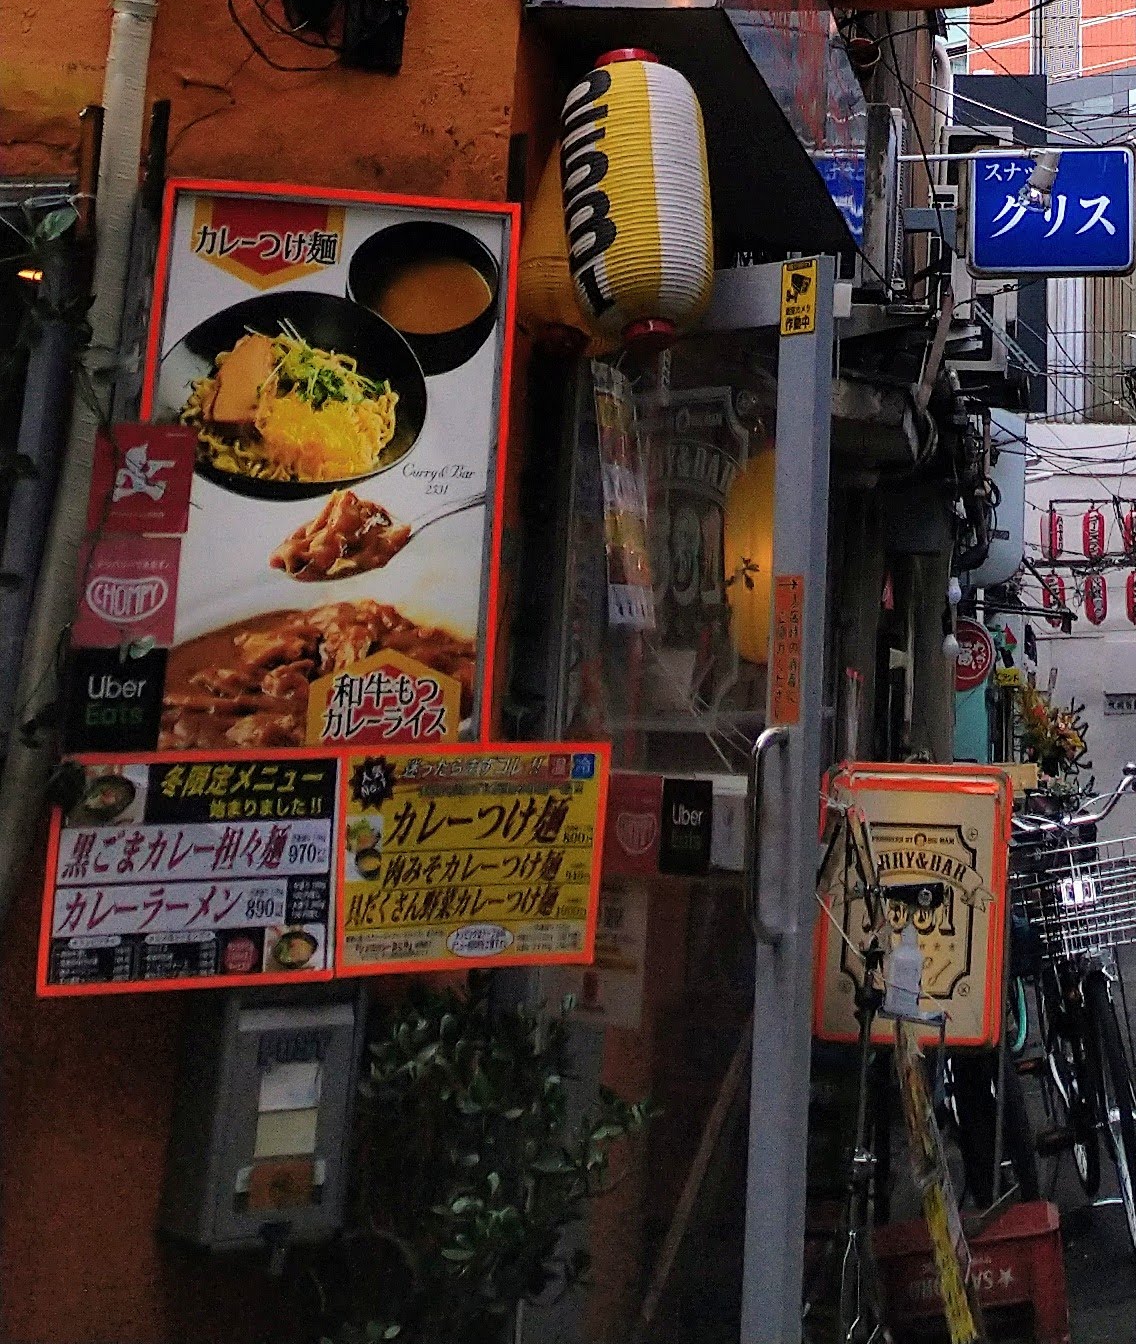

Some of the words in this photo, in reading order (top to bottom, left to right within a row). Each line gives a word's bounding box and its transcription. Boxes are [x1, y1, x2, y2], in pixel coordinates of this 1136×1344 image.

[194, 225, 339, 265] カレーつけ麺
[95, 583, 159, 616] CHOMPY
[87, 675, 147, 700] Uber
[333, 673, 439, 708] 和牛もつ
[320, 705, 447, 738] カレーライス
[160, 763, 325, 798] 冬限定メニュー
[383, 794, 573, 846] カレーつけ麺
[671, 802, 704, 826] Uber
[60, 824, 292, 879] 黒ごまカレー担々麺
[288, 843, 317, 864] 970
[876, 851, 968, 883] RRY&BAR
[56, 884, 244, 932] カレーラーメン
[245, 897, 275, 920] 890
